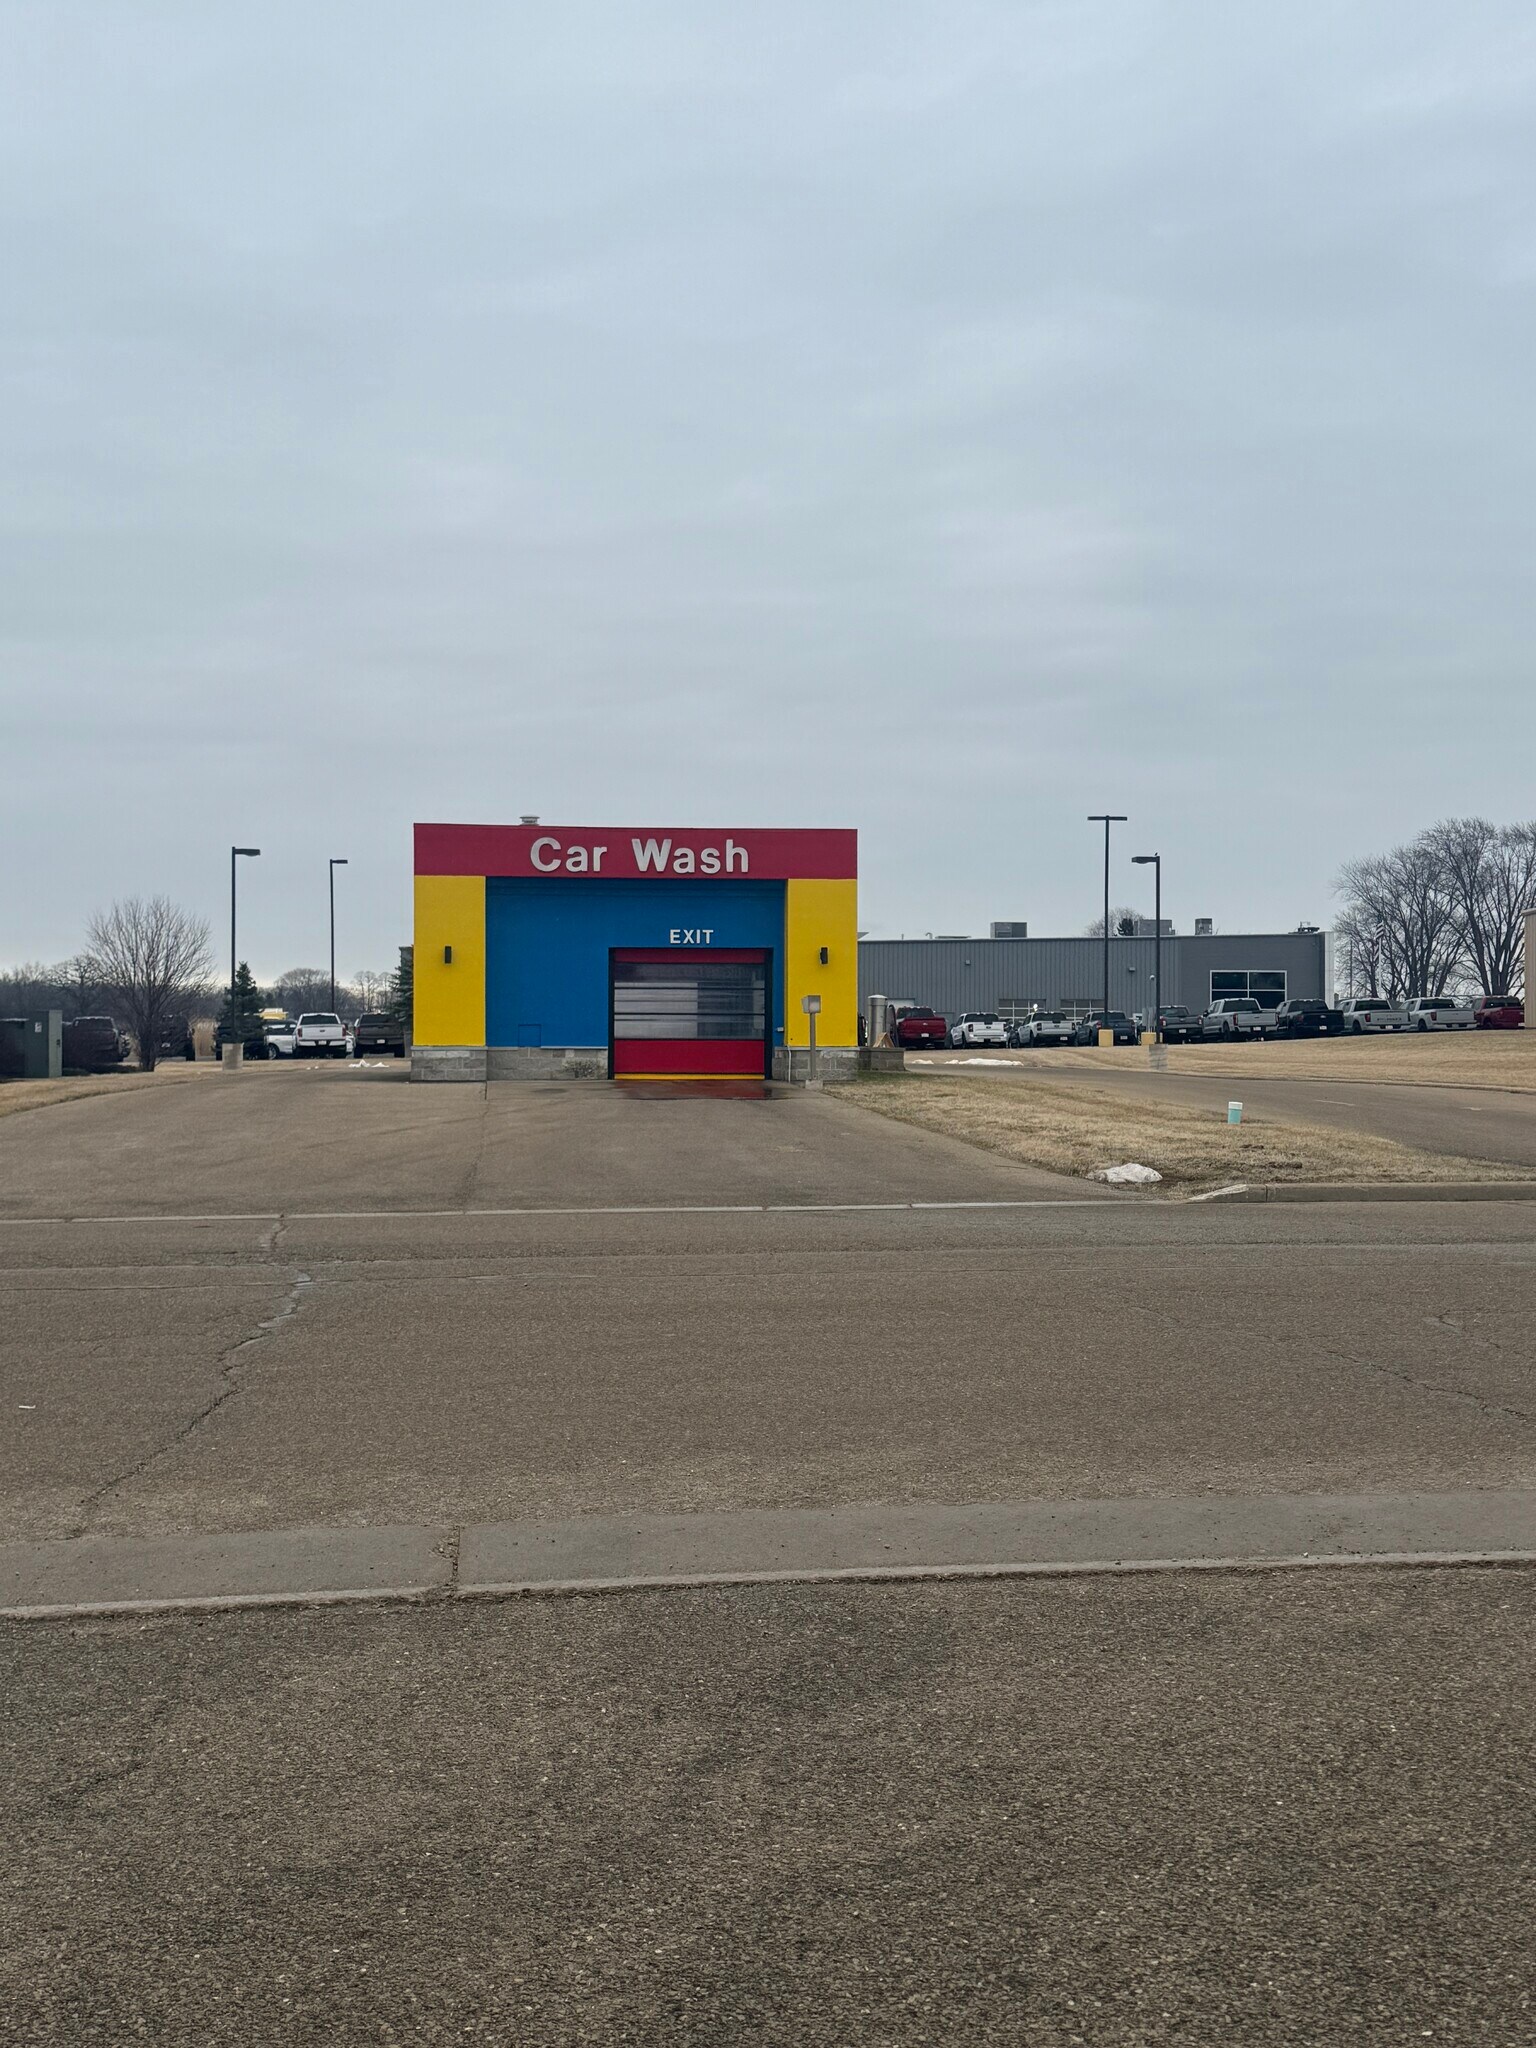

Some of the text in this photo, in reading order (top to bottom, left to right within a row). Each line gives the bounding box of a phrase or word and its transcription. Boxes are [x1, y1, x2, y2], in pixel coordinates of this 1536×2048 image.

[530, 837, 750, 874] Car Wash
[669, 929, 714, 944] EXIT
